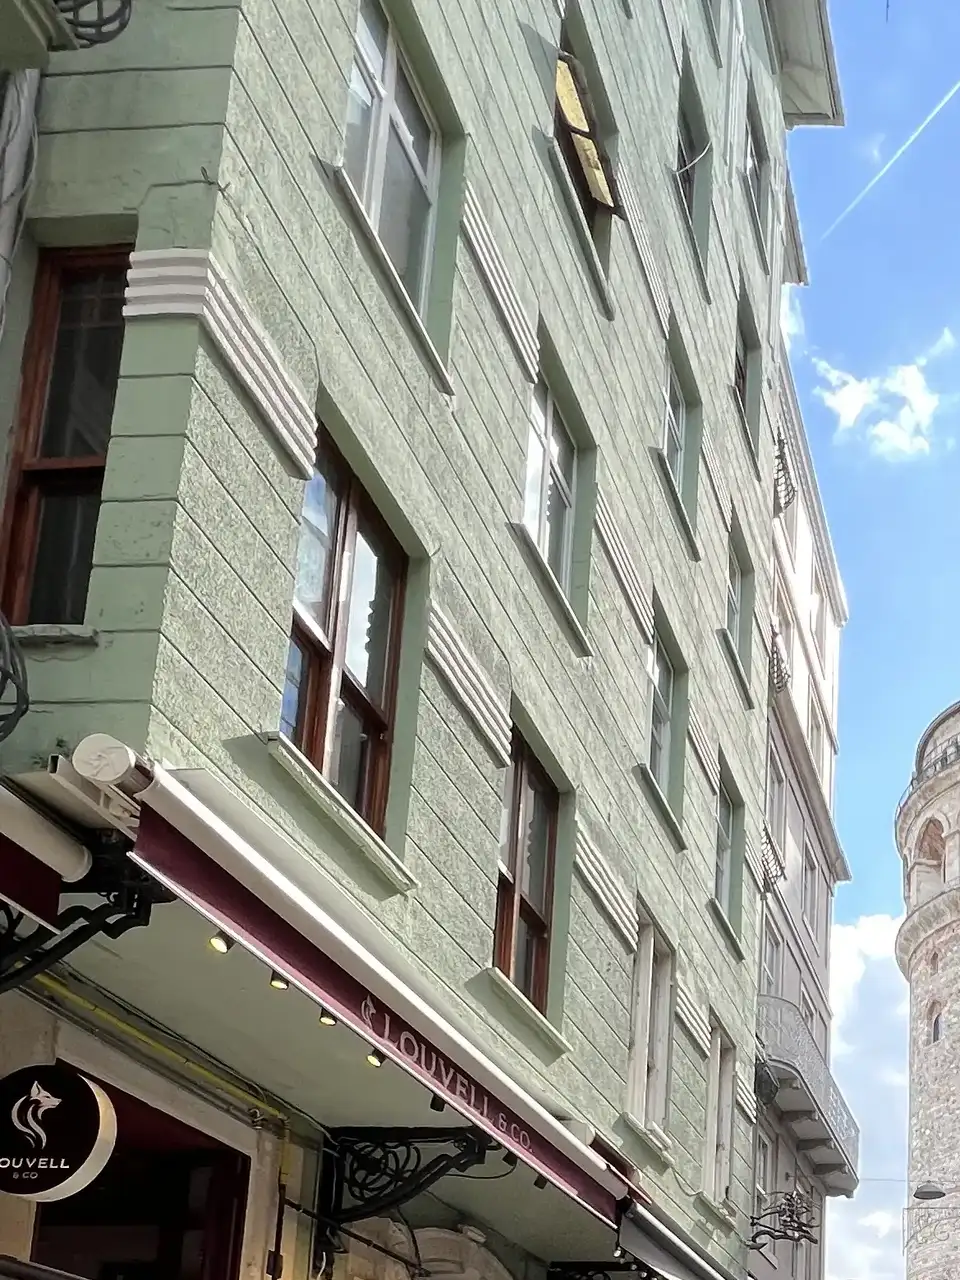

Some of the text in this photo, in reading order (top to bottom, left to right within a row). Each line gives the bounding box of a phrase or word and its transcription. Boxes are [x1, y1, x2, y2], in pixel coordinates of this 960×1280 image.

[384, 1013, 493, 1126] LOUVELL
[0, 1157, 70, 1169] OUVELL
[22, 1171, 39, 1179] CO
